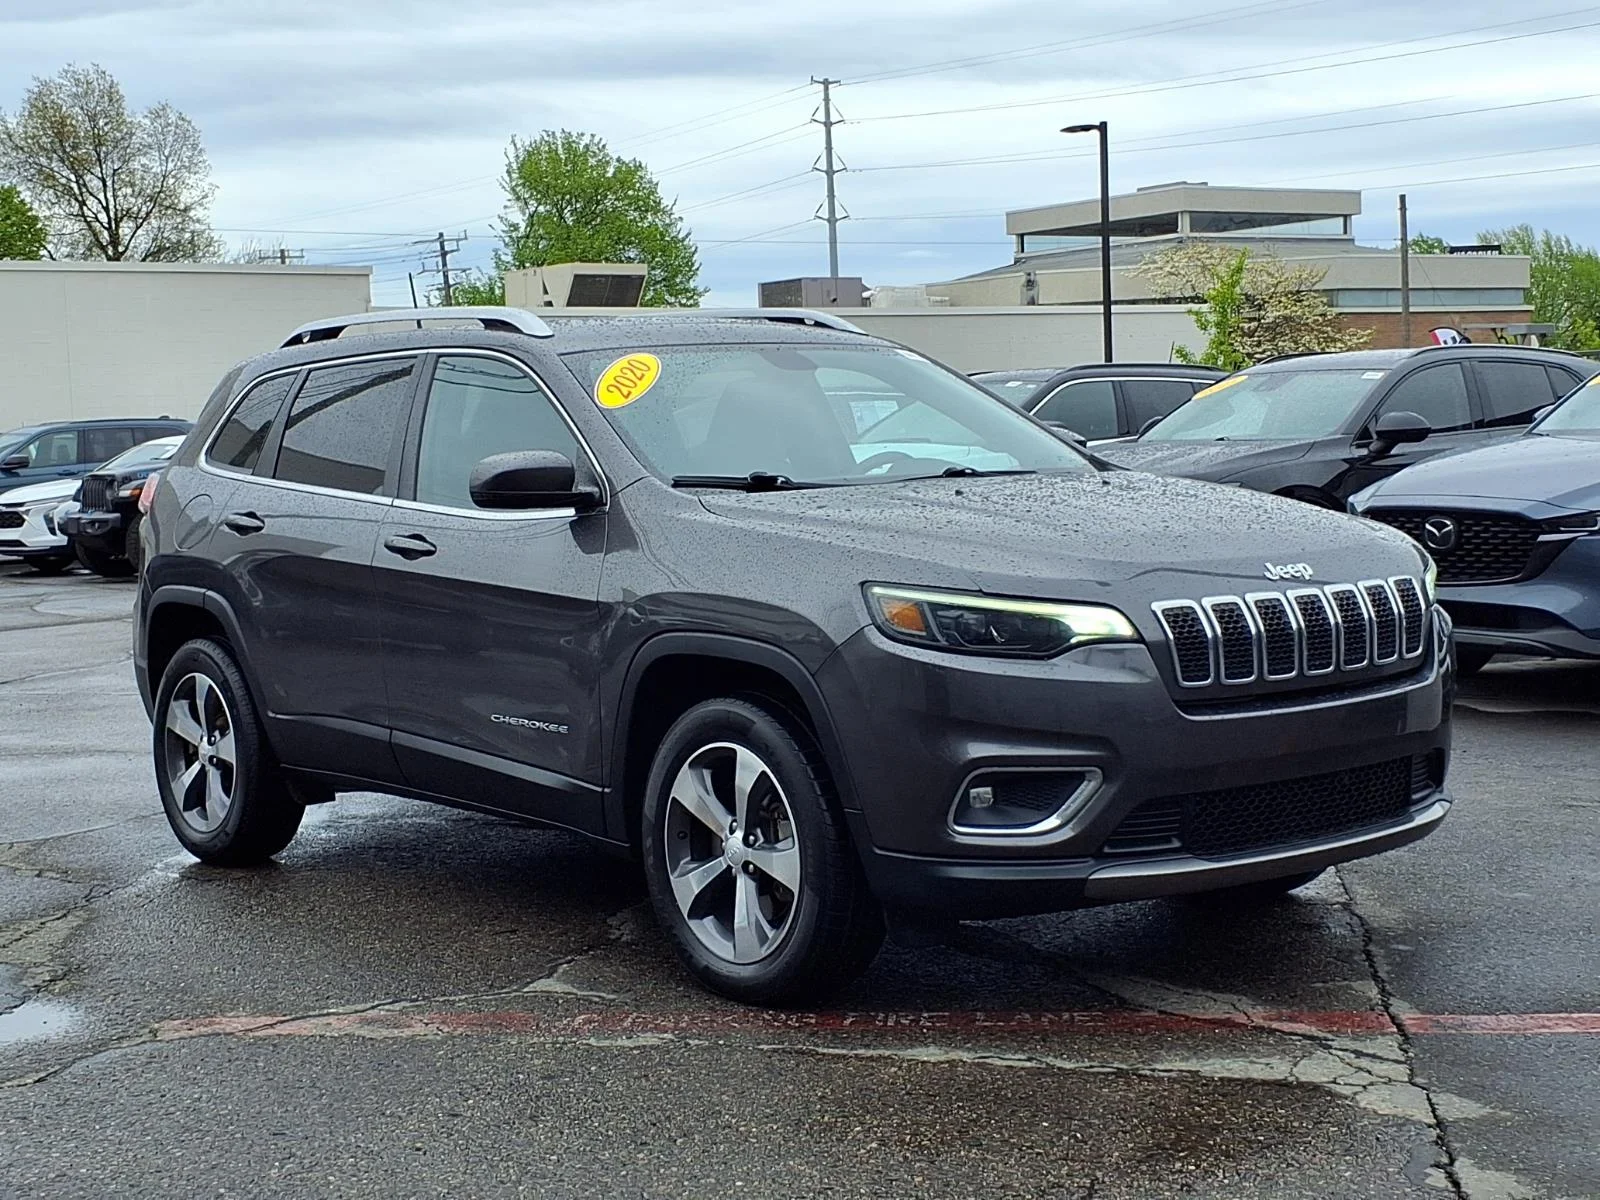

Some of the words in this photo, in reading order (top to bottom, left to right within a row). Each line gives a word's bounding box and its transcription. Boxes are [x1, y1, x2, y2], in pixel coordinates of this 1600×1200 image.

[606, 359, 651, 400] 2020
[1263, 562, 1313, 580] Jeep
[490, 714, 569, 734] CHEROKEE
[974, 1011, 1105, 1027] LANE
